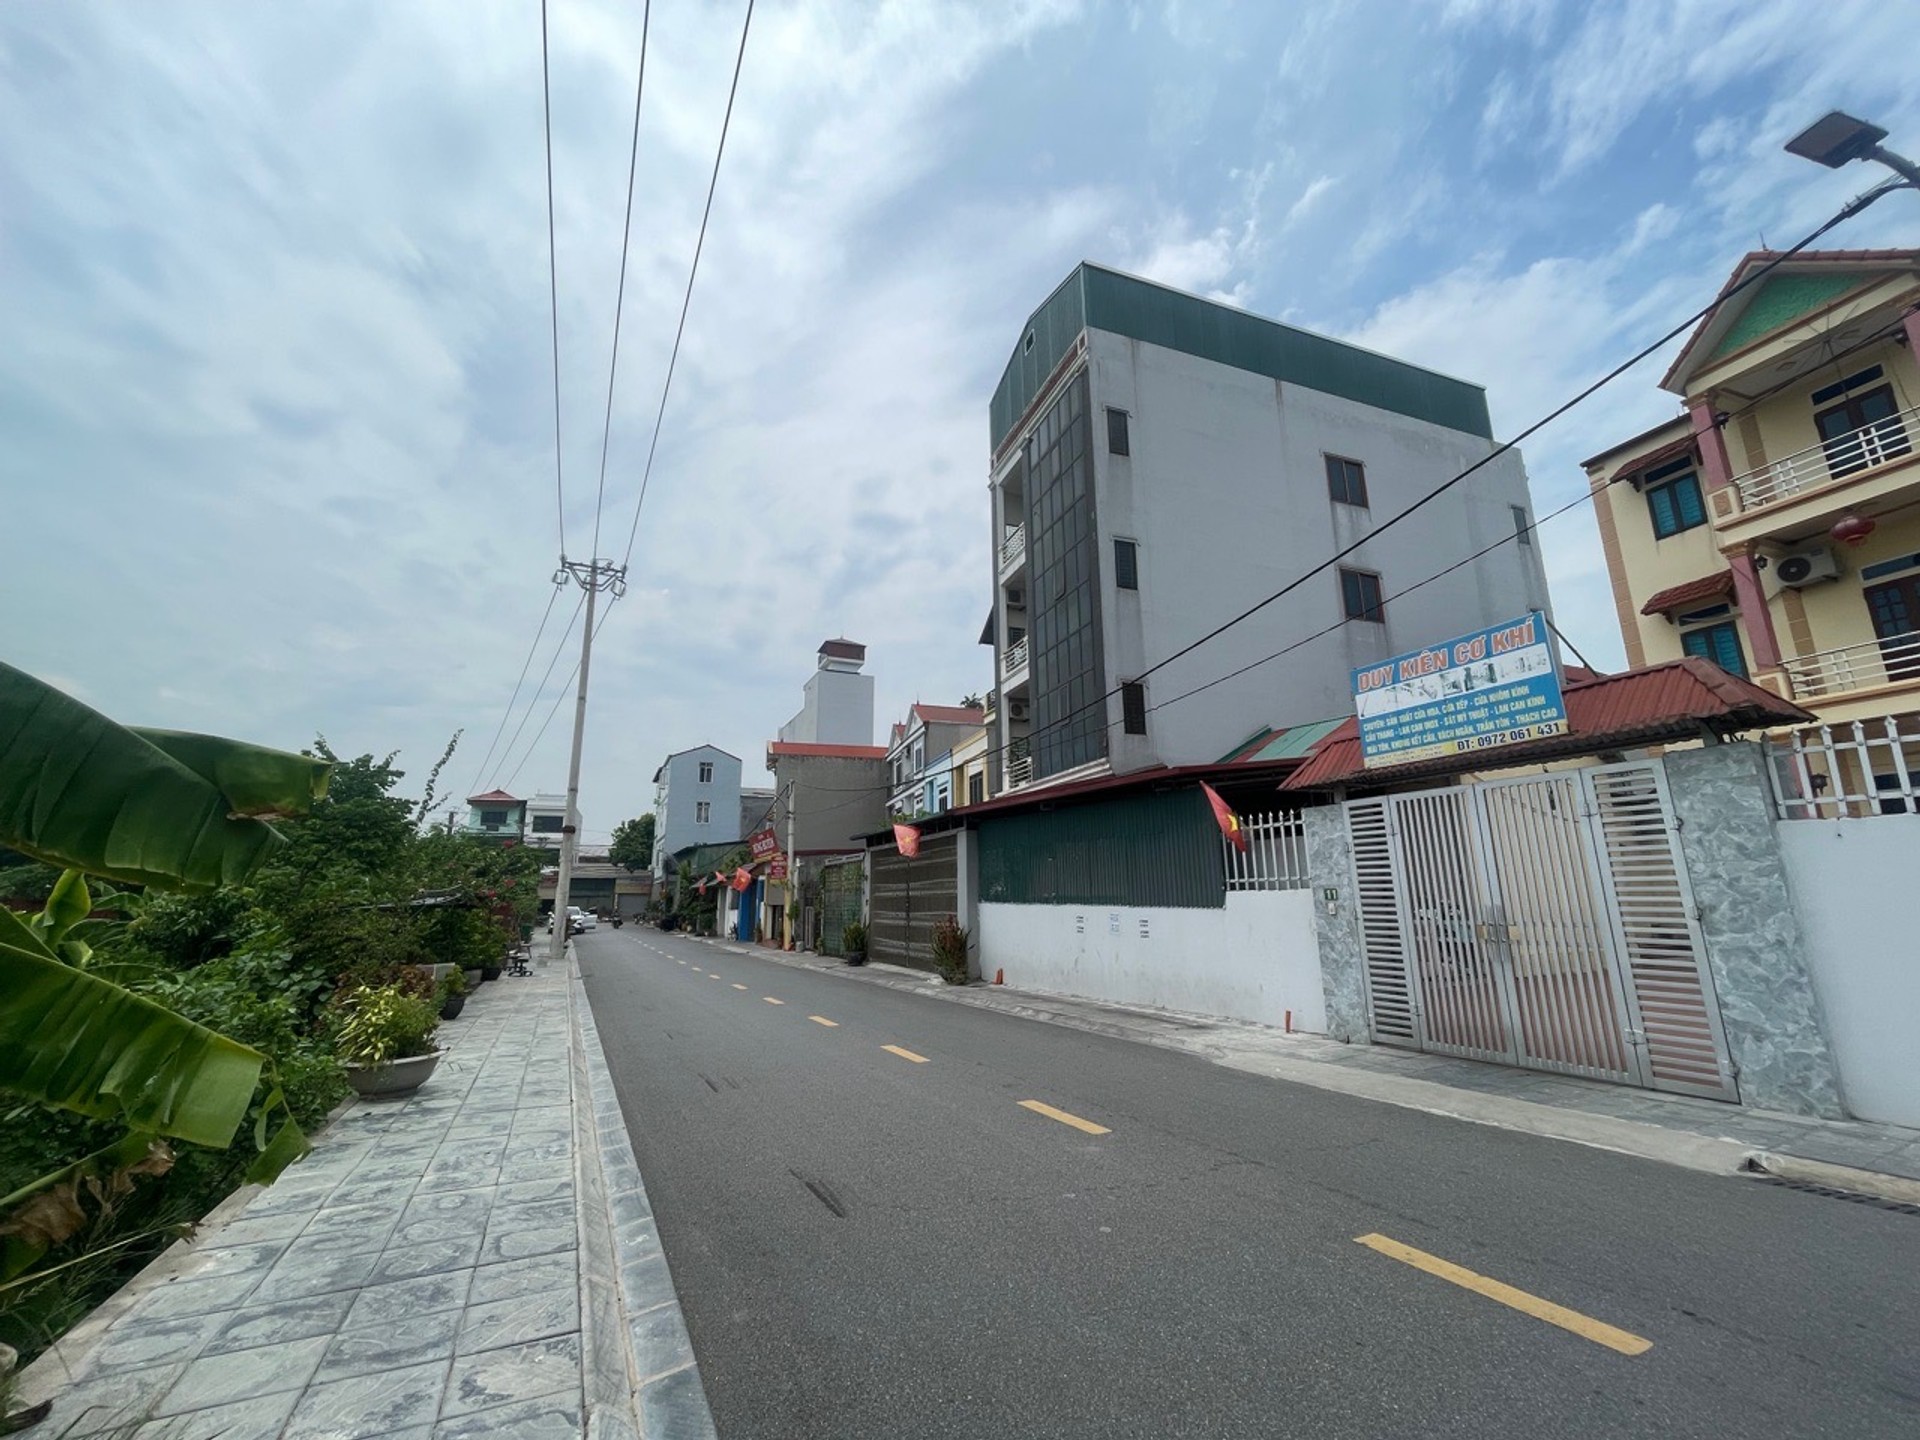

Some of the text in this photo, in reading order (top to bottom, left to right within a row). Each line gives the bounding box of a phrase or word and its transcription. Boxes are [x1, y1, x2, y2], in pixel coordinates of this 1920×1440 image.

[1358, 617, 1535, 692] DUY KIÊN CƠ KHÍ
[1442, 701, 1455, 713] CỬA
[1474, 693, 1487, 704] CỬA
[1489, 689, 1510, 701] NHÔM
[1511, 685, 1529, 696] KÍNH
[1376, 729, 1394, 739] THANG
[1398, 727, 1410, 735] LAN
[1411, 723, 1423, 732] CAN
[1495, 704, 1509, 714] LAN
[1510, 700, 1525, 710] CAN
[1542, 708, 1557, 718] CAO
[1477, 733, 1506, 747] 0972
[1510, 728, 1531, 741] 061
[1537, 723, 1560, 735] 431
[1327, 890, 1337, 899] 11
